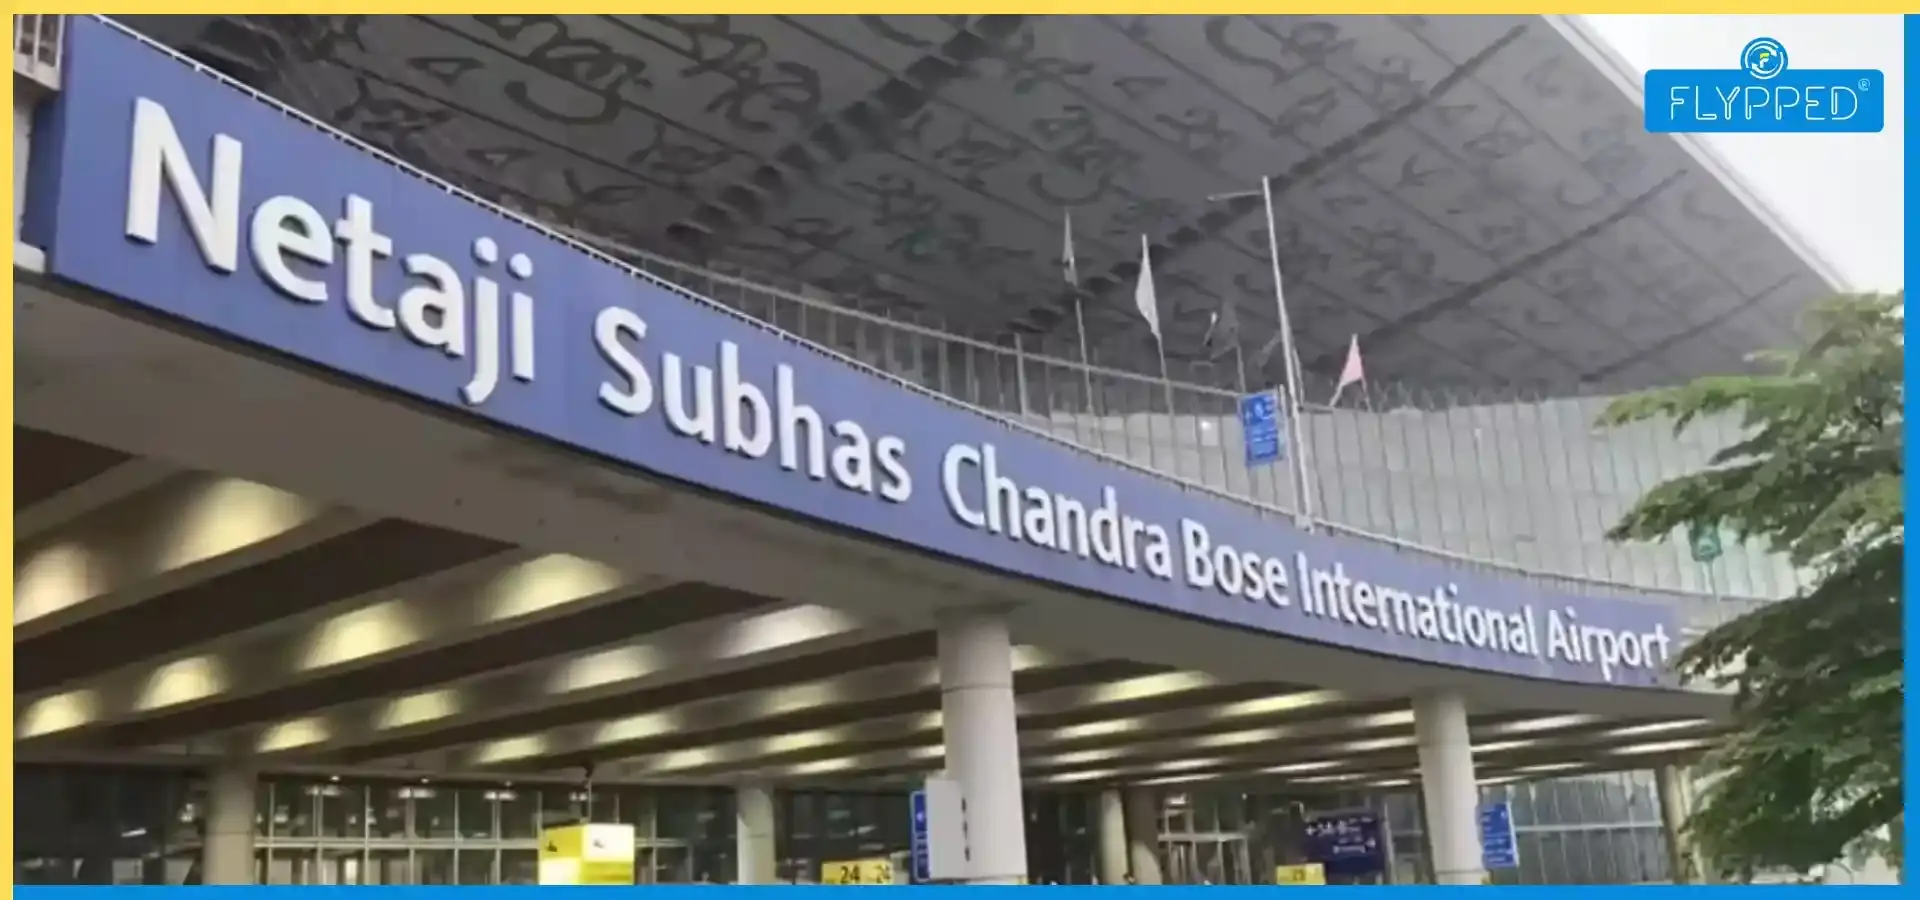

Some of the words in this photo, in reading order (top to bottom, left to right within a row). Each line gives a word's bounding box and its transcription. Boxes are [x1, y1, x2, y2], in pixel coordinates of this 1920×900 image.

[125, 96, 534, 405] Netaji
[594, 305, 913, 503] Subhas
[942, 442, 1173, 580] Chandra
[1181, 517, 1290, 607] Bose
[1296, 551, 1540, 657] International
[1546, 605, 1671, 682] Airport
[839, 864, 860, 884] 24
